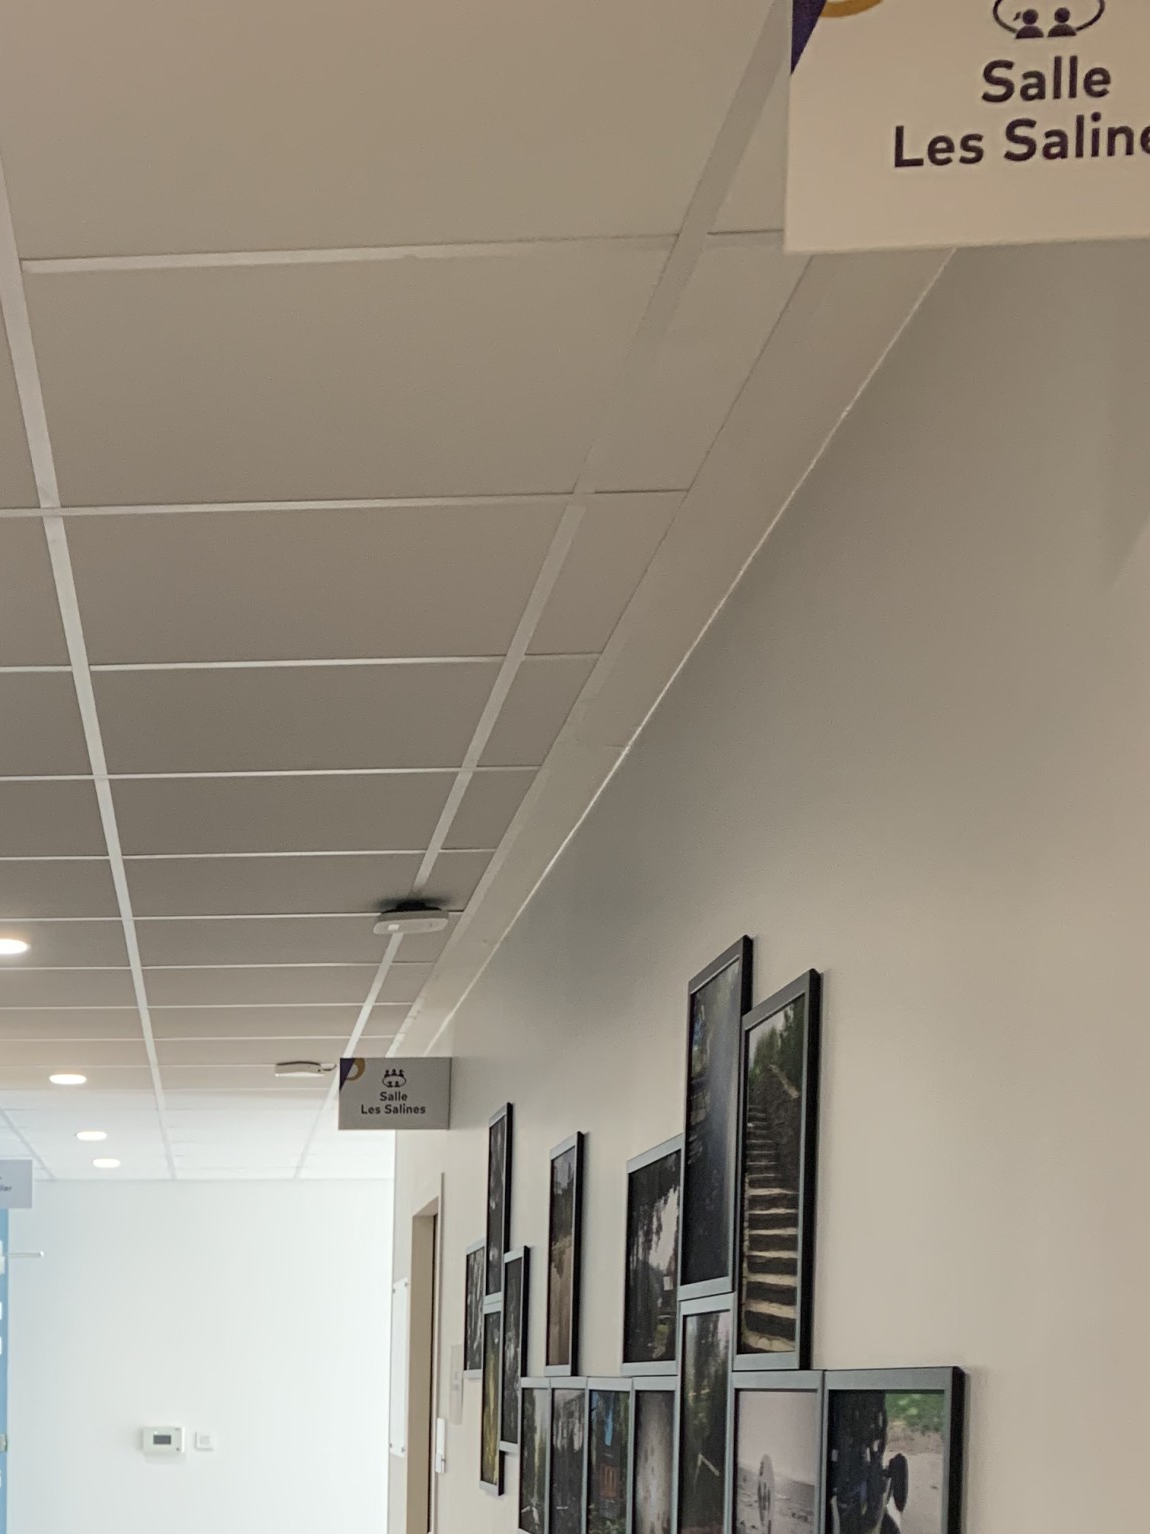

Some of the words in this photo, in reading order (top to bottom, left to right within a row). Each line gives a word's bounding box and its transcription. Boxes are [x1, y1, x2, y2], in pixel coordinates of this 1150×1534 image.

[981, 55, 1112, 103] Salle
[894, 125, 984, 168] Les
[360, 1104, 381, 1115] Les
[384, 1103, 426, 1115] Salines
[379, 1091, 408, 1102] Salle
